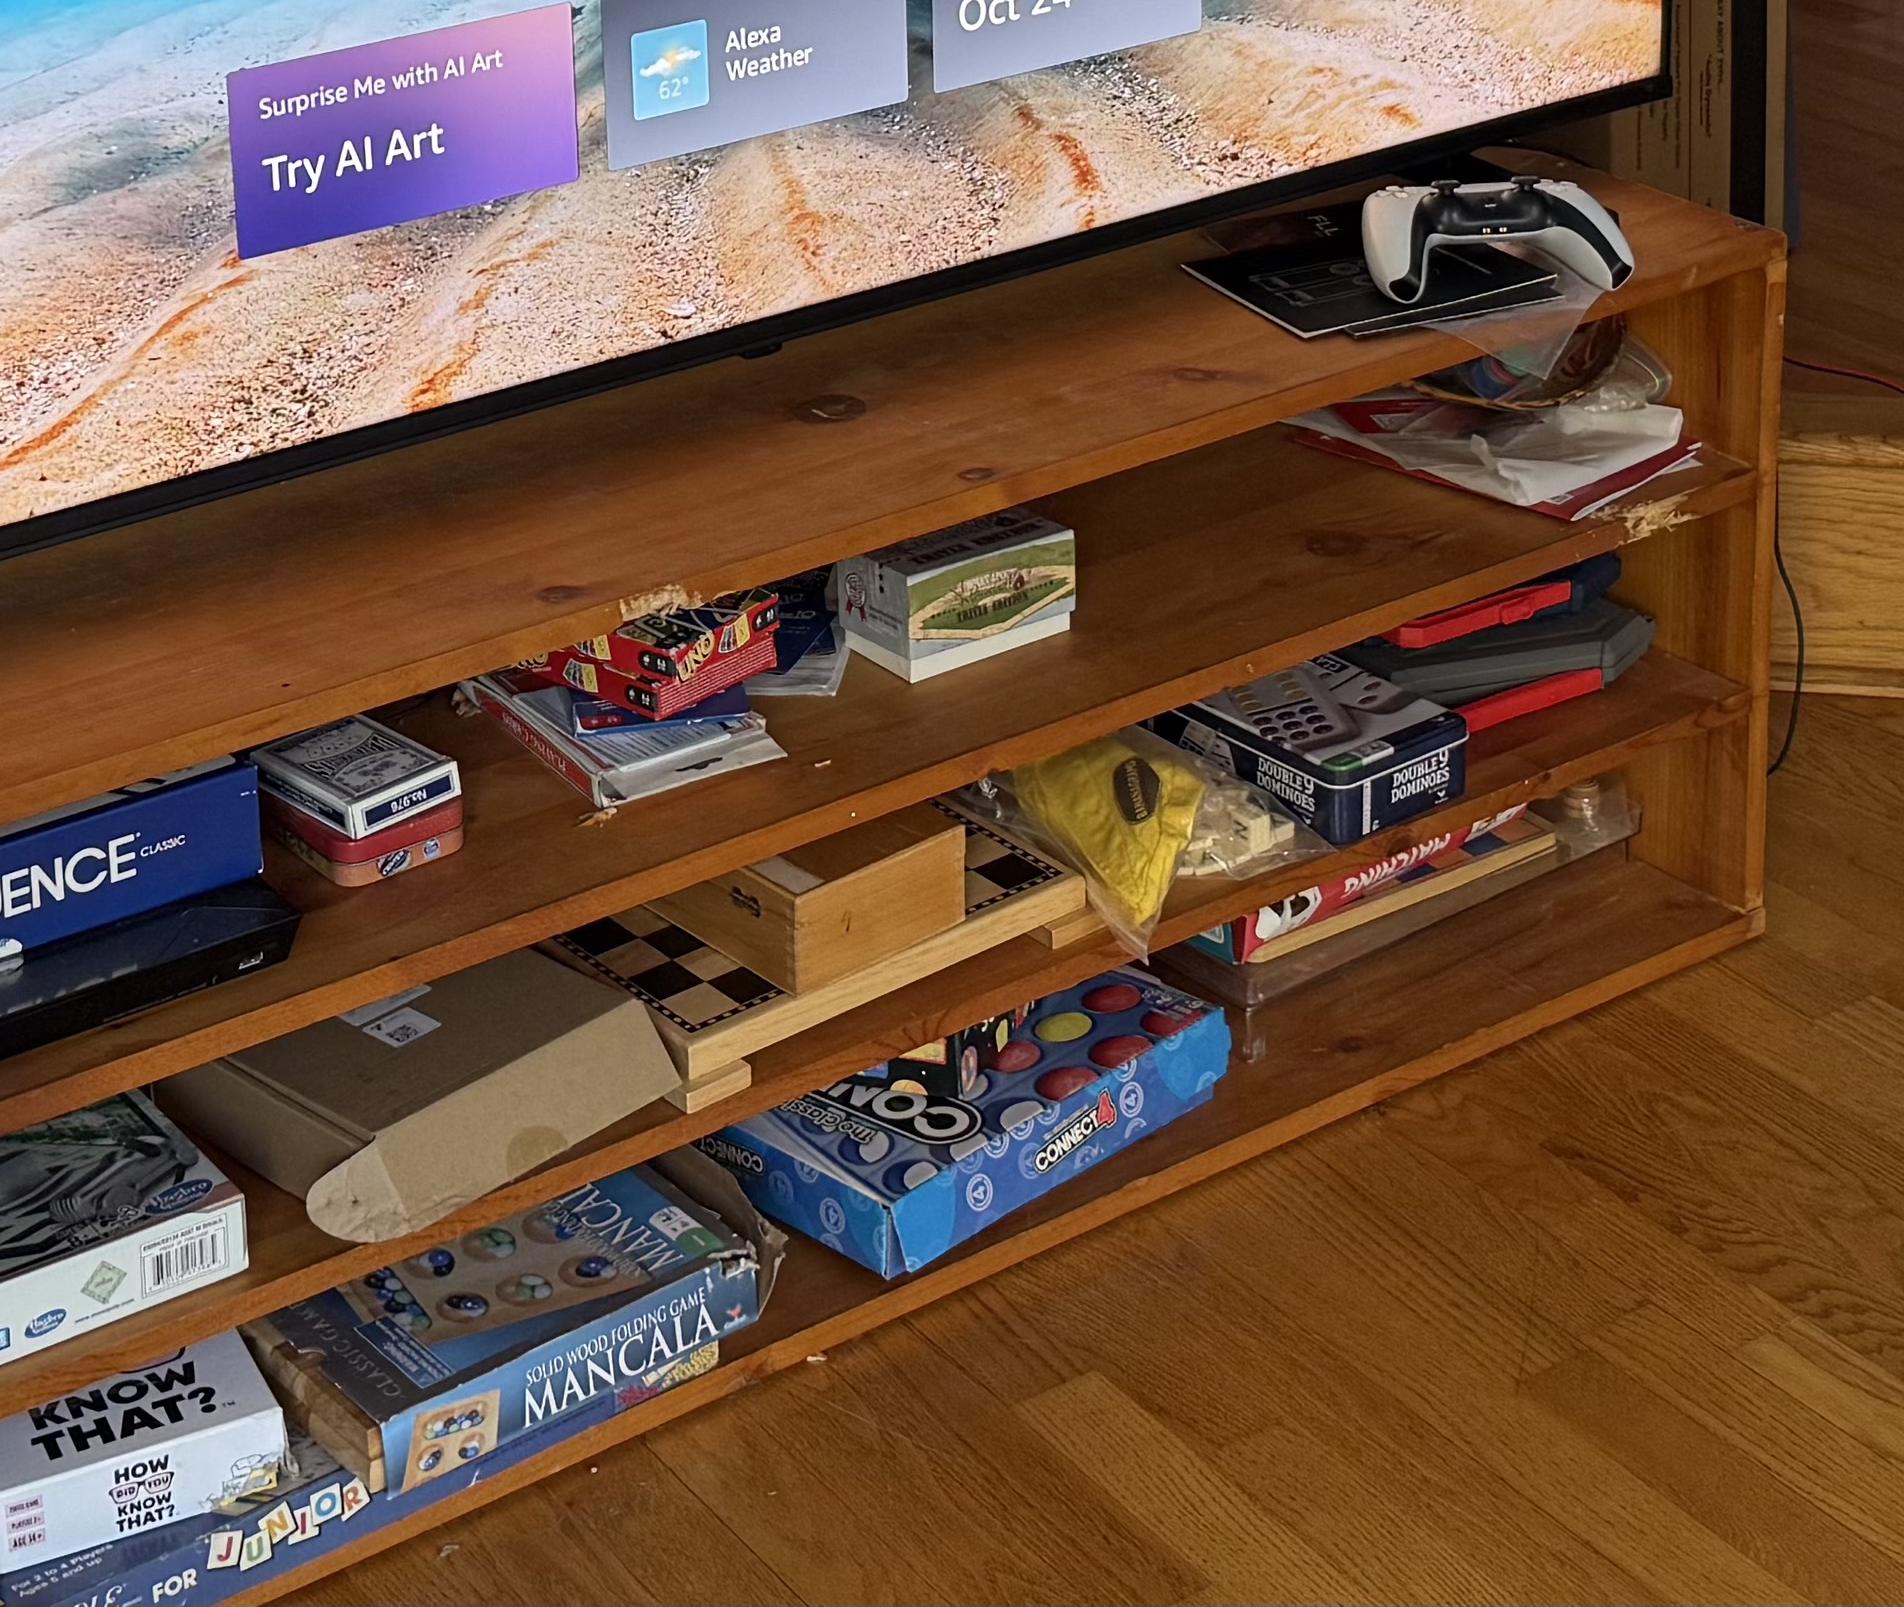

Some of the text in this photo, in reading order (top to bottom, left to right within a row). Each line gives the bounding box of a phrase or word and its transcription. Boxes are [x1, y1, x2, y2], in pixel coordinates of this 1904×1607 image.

[725, 25, 782, 54] Alexa
[725, 46, 814, 82] Weather
[258, 49, 504, 120] Surprise Me with AI Art
[261, 122, 446, 194] Try AI Art
[677, 630, 714, 684] UNO
[1257, 757, 1303, 791] DOUBLE
[1391, 767, 1450, 804] DOMINOES
[1392, 756, 1439, 788] DOUBLE
[1256, 772, 1316, 813] DOMINOES
[140, 834, 187, 857] CLASSIC
[1343, 832, 1451, 898] MATCHING
[1035, 1108, 1099, 1171] CONNECT
[525, 1286, 707, 1387] SOLID WOOD FOLDING GAME
[332, 1340, 401, 1397] CLASSIC
[523, 1304, 721, 1430] MANCALA
[28, 1360, 196, 1431] KNOW
[30, 1386, 216, 1461] THAT?
[114, 1454, 170, 1485] HOW
[116, 1476, 170, 1499] DID YOU
[116, 1504, 176, 1532] THAT?
[117, 1491, 172, 1517] KNOW
[217, 1486, 363, 1563] JUNIOR
[62, 1564, 85, 1580] and
[87, 1556, 103, 1570] up
[152, 1568, 198, 1605] FOR
